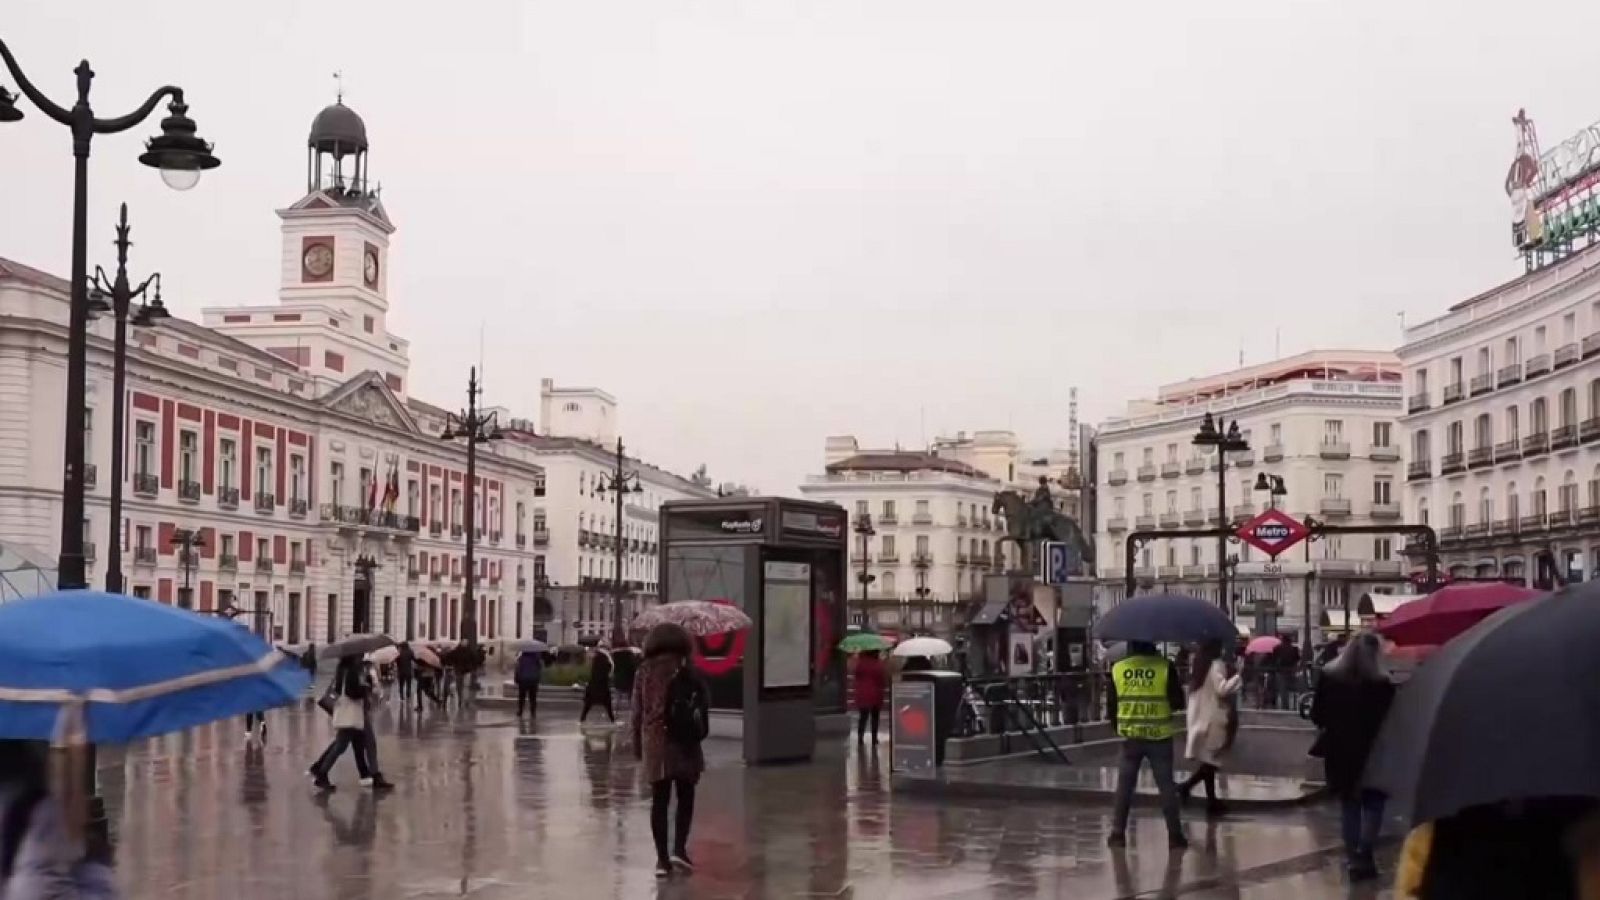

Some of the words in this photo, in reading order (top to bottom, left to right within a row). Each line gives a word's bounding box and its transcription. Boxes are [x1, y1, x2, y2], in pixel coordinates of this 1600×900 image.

[1256, 526, 1288, 537] Metro
[1051, 547, 1063, 581] P
[1263, 564, 1282, 573] Sol
[1124, 668, 1155, 679] ORO
